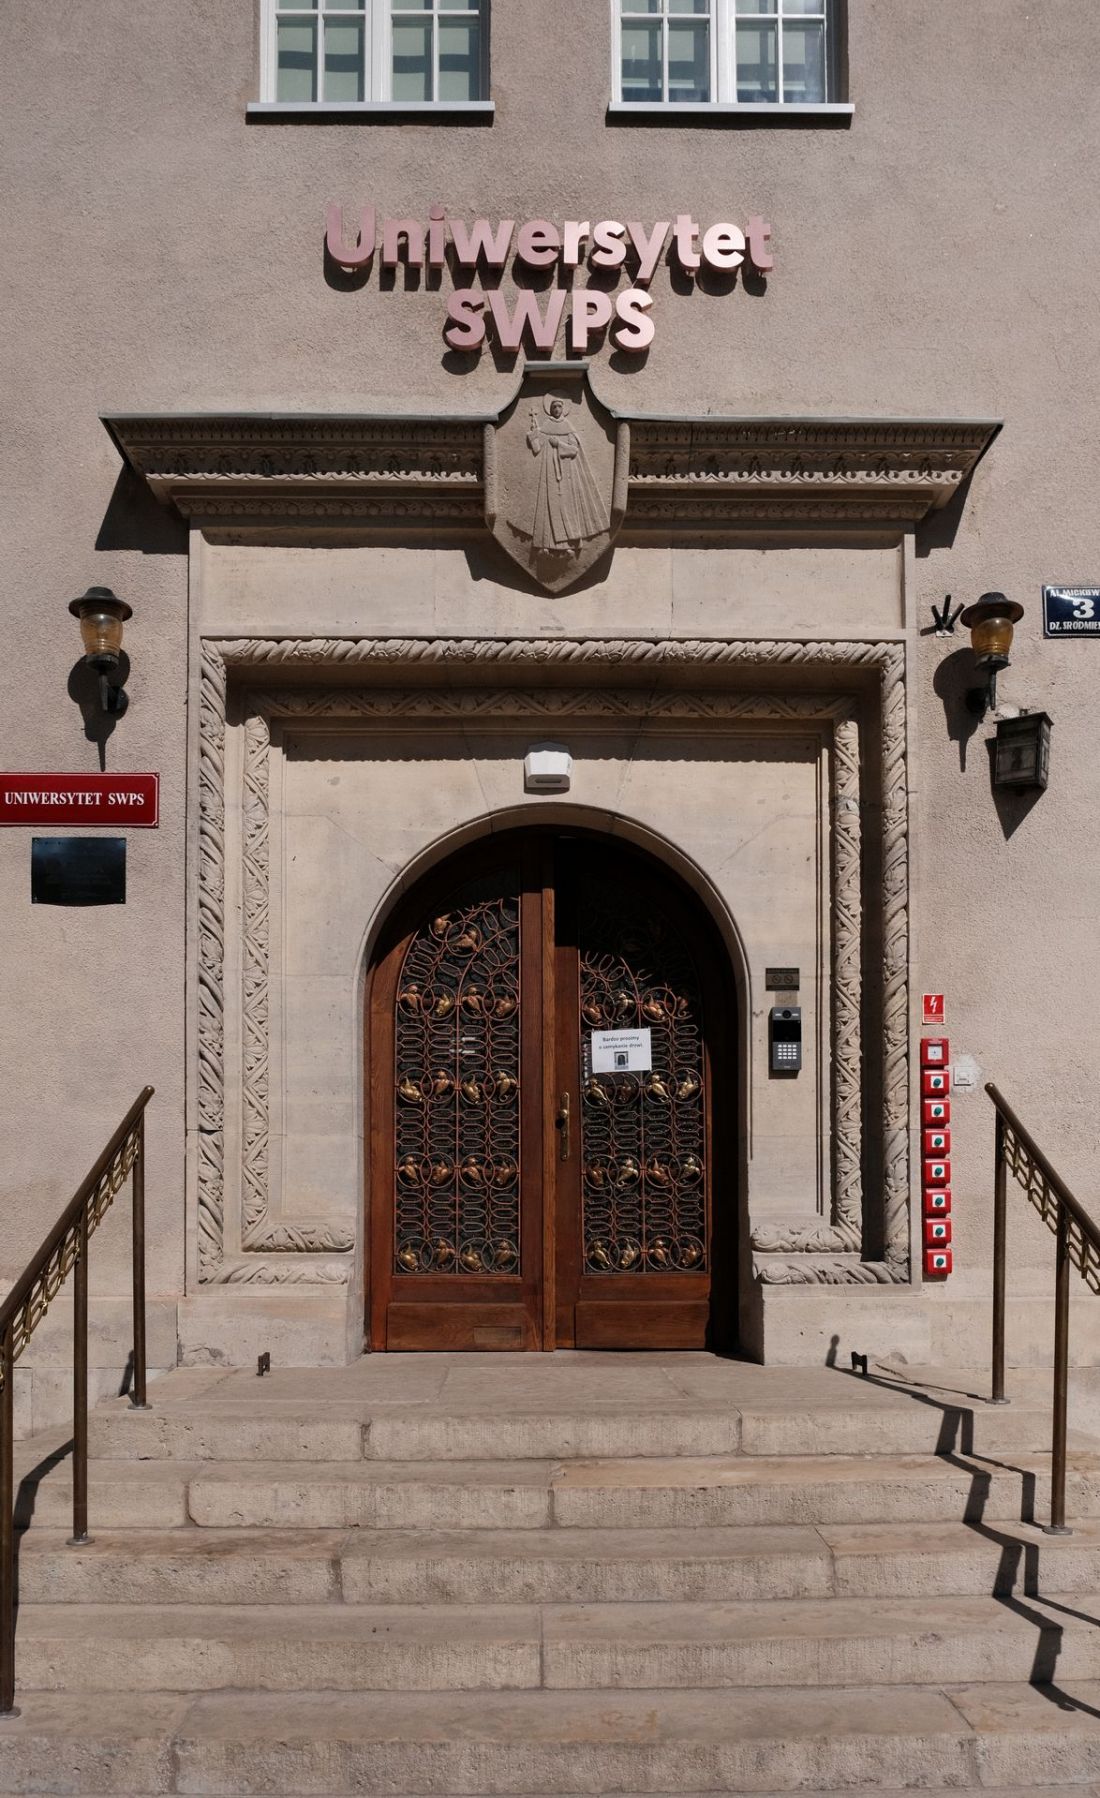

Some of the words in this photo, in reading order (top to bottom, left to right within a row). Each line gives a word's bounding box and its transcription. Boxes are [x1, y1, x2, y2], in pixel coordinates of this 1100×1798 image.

[326, 205, 774, 284] Uniwersytet
[445, 288, 655, 352] SWPS
[1072, 598, 1095, 618] 3
[1050, 621, 1062, 630] DZ.
[4, 792, 102, 805] UNIWERSYTET
[108, 792, 145, 805] SWPS
